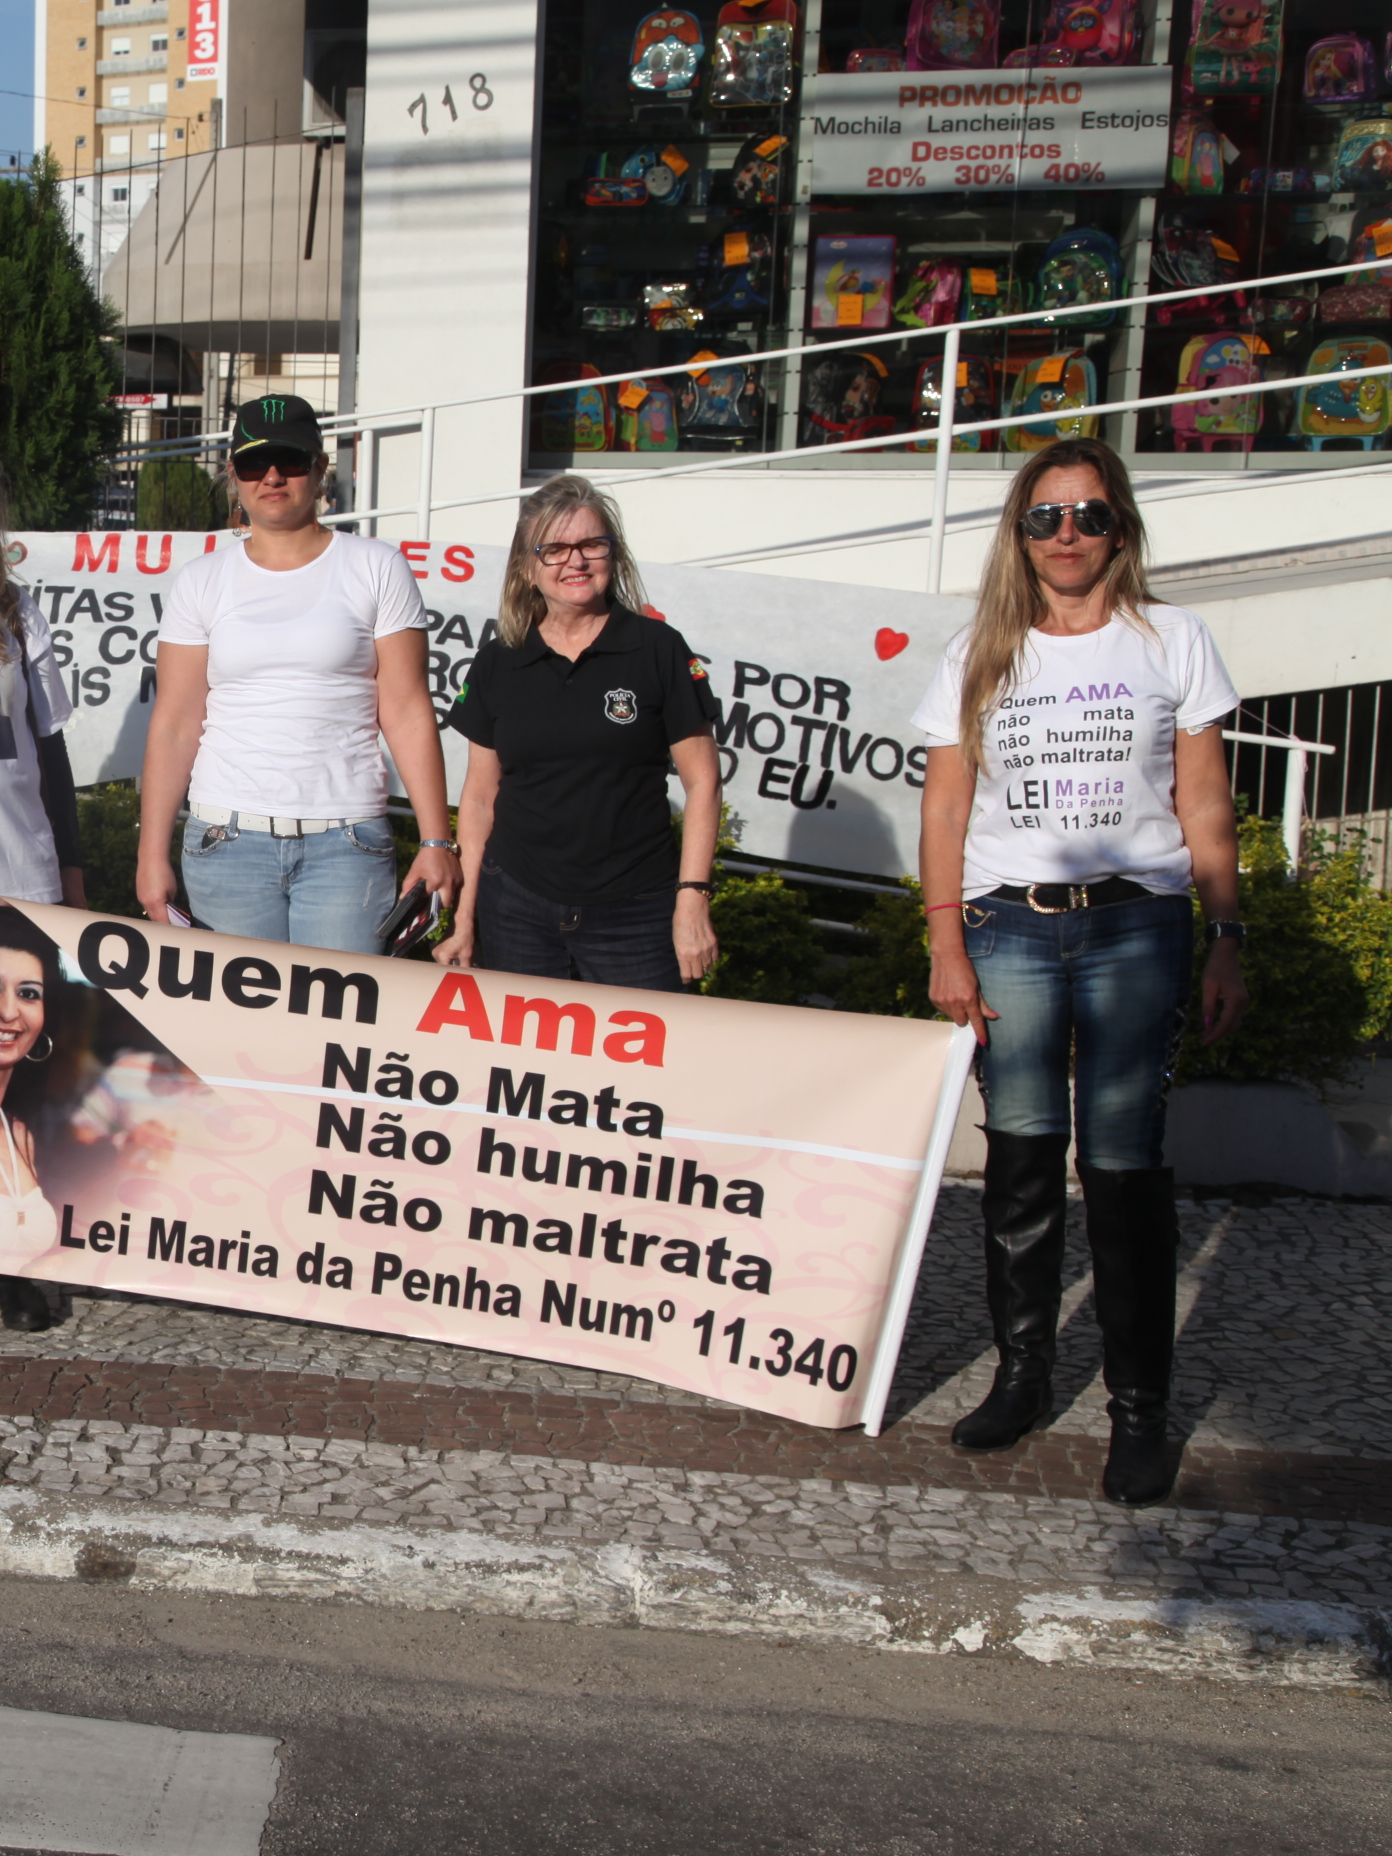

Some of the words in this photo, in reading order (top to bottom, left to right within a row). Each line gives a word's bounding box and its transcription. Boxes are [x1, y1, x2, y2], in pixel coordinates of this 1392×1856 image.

[407, 72, 494, 136] 718
[814, 115, 902, 135] Mochila
[927, 113, 1055, 133] Lancheiras
[1081, 109, 1169, 132] Estojos
[911, 141, 1062, 162] Descontos
[867, 167, 926, 187] 20%
[955, 164, 1015, 185] 30%
[1044, 162, 1105, 183] 40%
[732, 660, 851, 722] POR
[999, 695, 1057, 710] Quem
[1064, 682, 1134, 703] AMA
[997, 714, 1031, 732] não
[1083, 706, 1135, 721] mata
[998, 733, 1031, 752] não
[1046, 726, 1133, 743] humilha
[1003, 753, 1034, 770] não
[1041, 747, 1131, 765] maltrata!
[758, 756, 837, 811] EU.
[1007, 779, 1049, 810] LEI
[1055, 777, 1124, 797] Maria
[1055, 799, 1074, 809] Da
[1080, 797, 1124, 808] Penha
[1010, 815, 1041, 829] LEI
[1060, 811, 1122, 830] 11.340
[77, 920, 380, 1025] Quem
[415, 971, 667, 1068] Ama
[321, 1041, 460, 1106] Não
[485, 1066, 665, 1140] Mata
[316, 1102, 452, 1166] Não
[476, 1126, 765, 1219] humilha
[307, 1169, 443, 1233] Não
[468, 1206, 773, 1295] maltrata
[59, 1204, 131, 1256] Lei
[146, 1216, 280, 1278] Maria
[295, 1241, 354, 1291] da
[371, 1251, 522, 1318] Penha
[539, 1279, 676, 1342] Numº
[692, 1309, 858, 1393] 11.340
